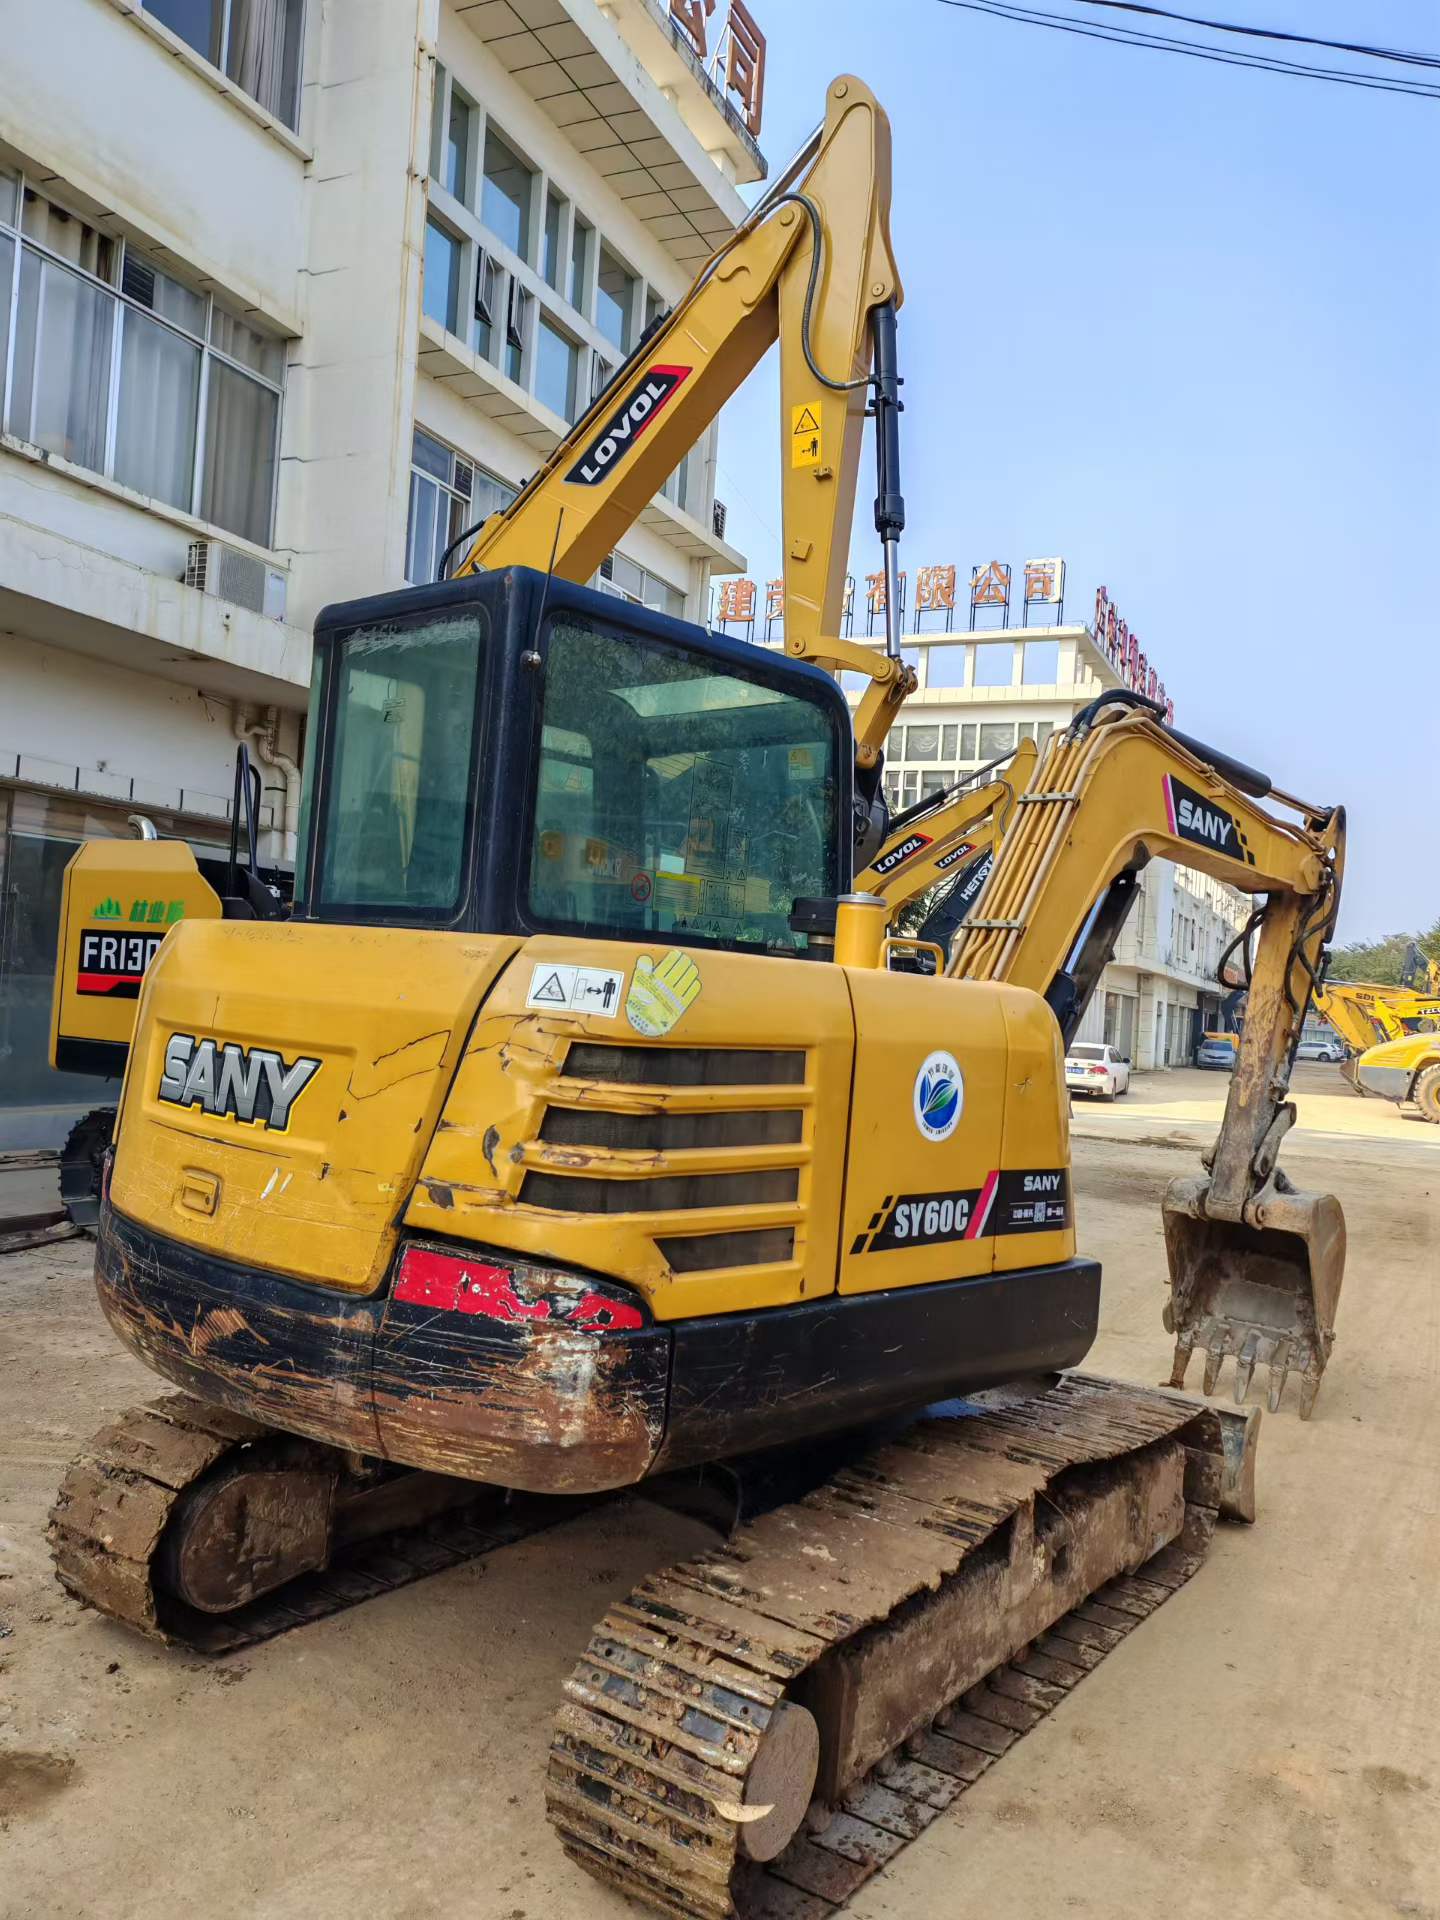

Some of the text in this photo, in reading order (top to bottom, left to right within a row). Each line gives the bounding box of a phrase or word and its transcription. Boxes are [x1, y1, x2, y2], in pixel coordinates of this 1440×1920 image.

[580, 382, 668, 482] LOVOL
[717, 556, 1064, 623] 建有限公司
[1178, 798, 1232, 845] SANY
[876, 839, 922, 872] LOVOL
[938, 845, 970, 867] LOVOL
[158, 1032, 323, 1131] SANY
[1023, 1175, 1060, 1192] SANY
[894, 1199, 969, 1239] SY60C
